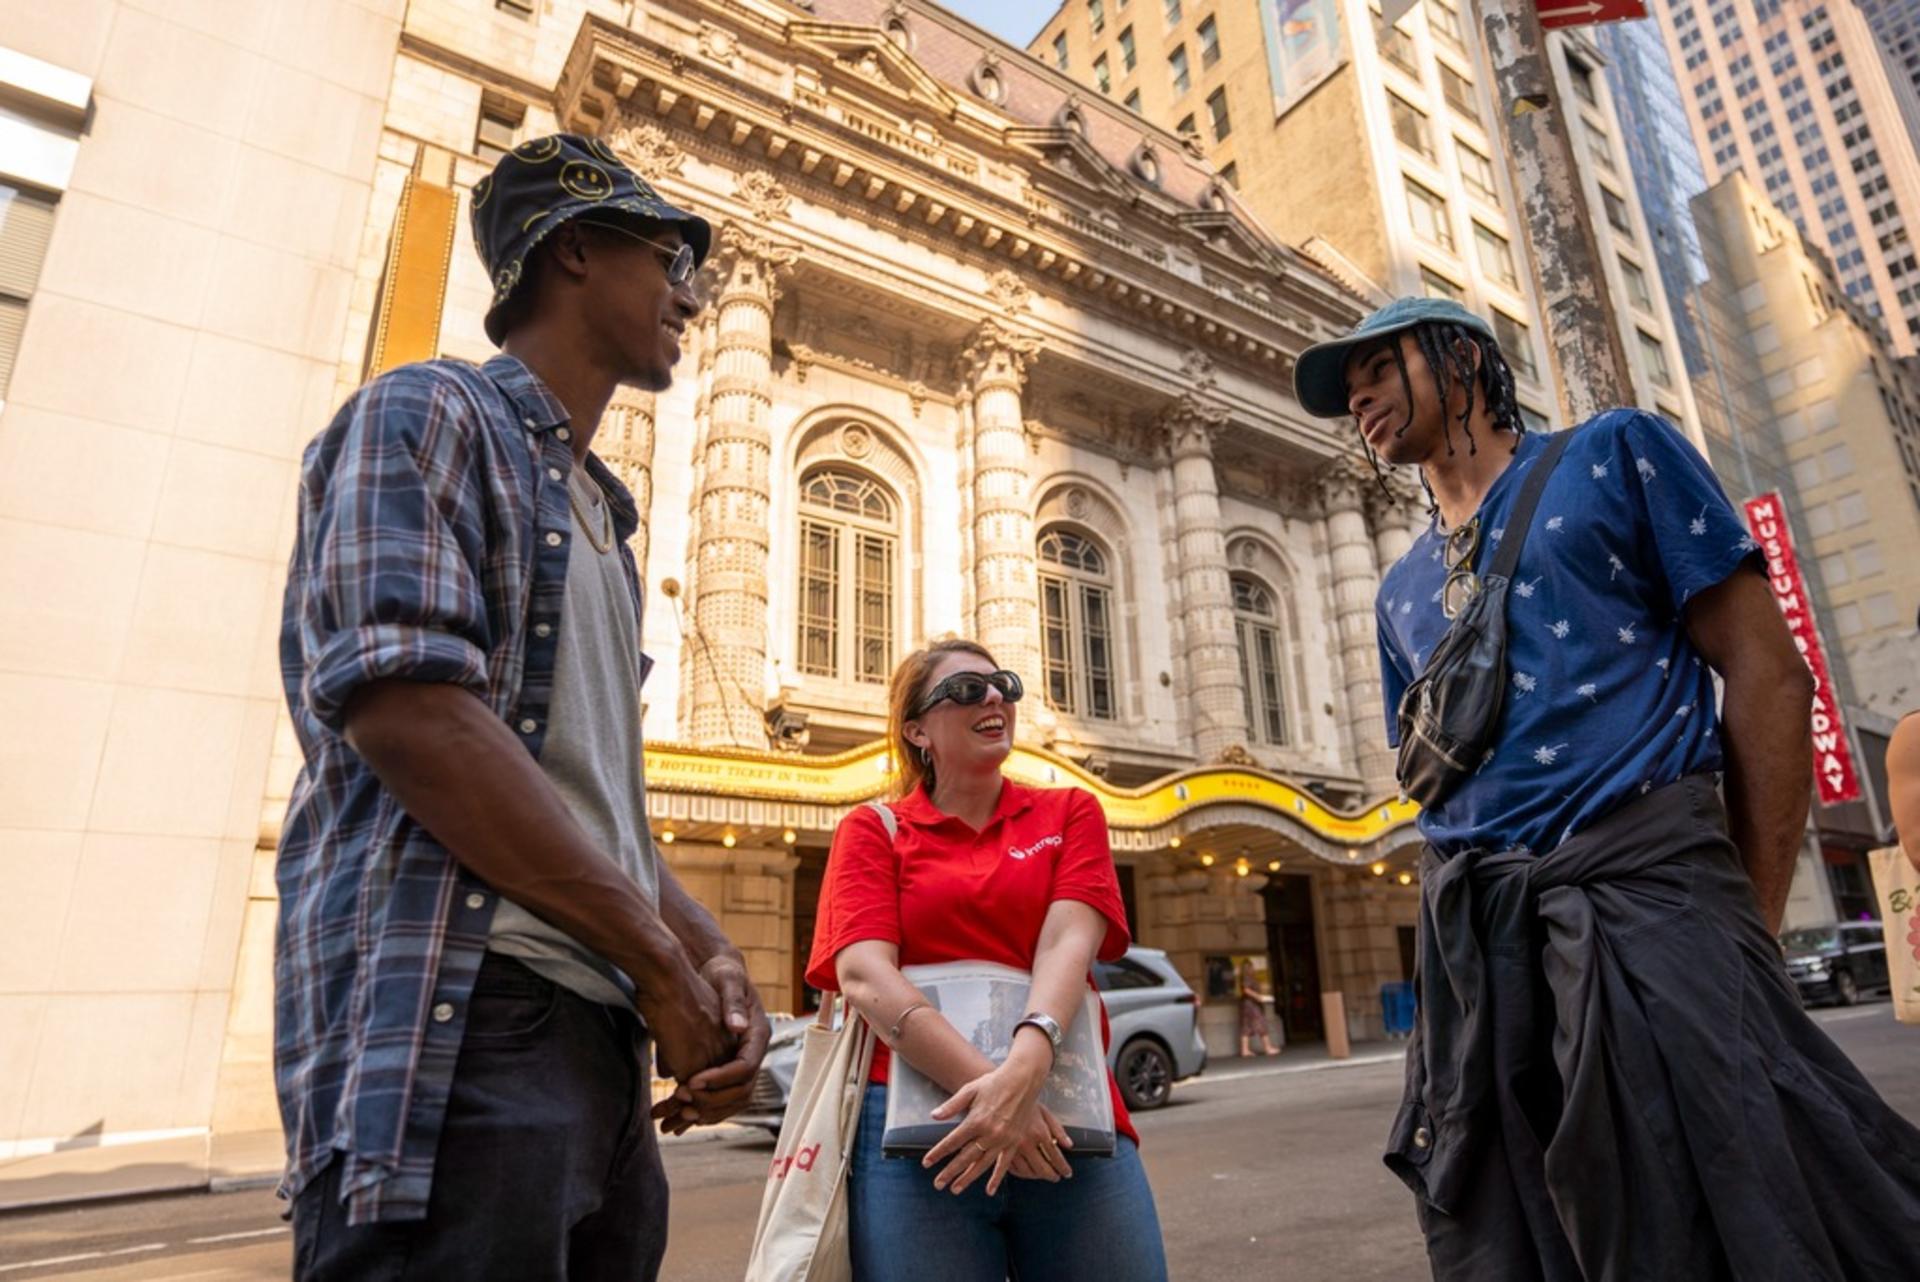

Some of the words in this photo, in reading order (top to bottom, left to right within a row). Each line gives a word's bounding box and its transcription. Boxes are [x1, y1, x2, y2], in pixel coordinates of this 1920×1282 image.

[1753, 502, 1801, 614] MUSEUM
[1793, 635, 1844, 793] BADWAY
[660, 759, 721, 776] HOTTEST
[727, 766, 773, 780] TICKET
[778, 771, 791, 781] IN
